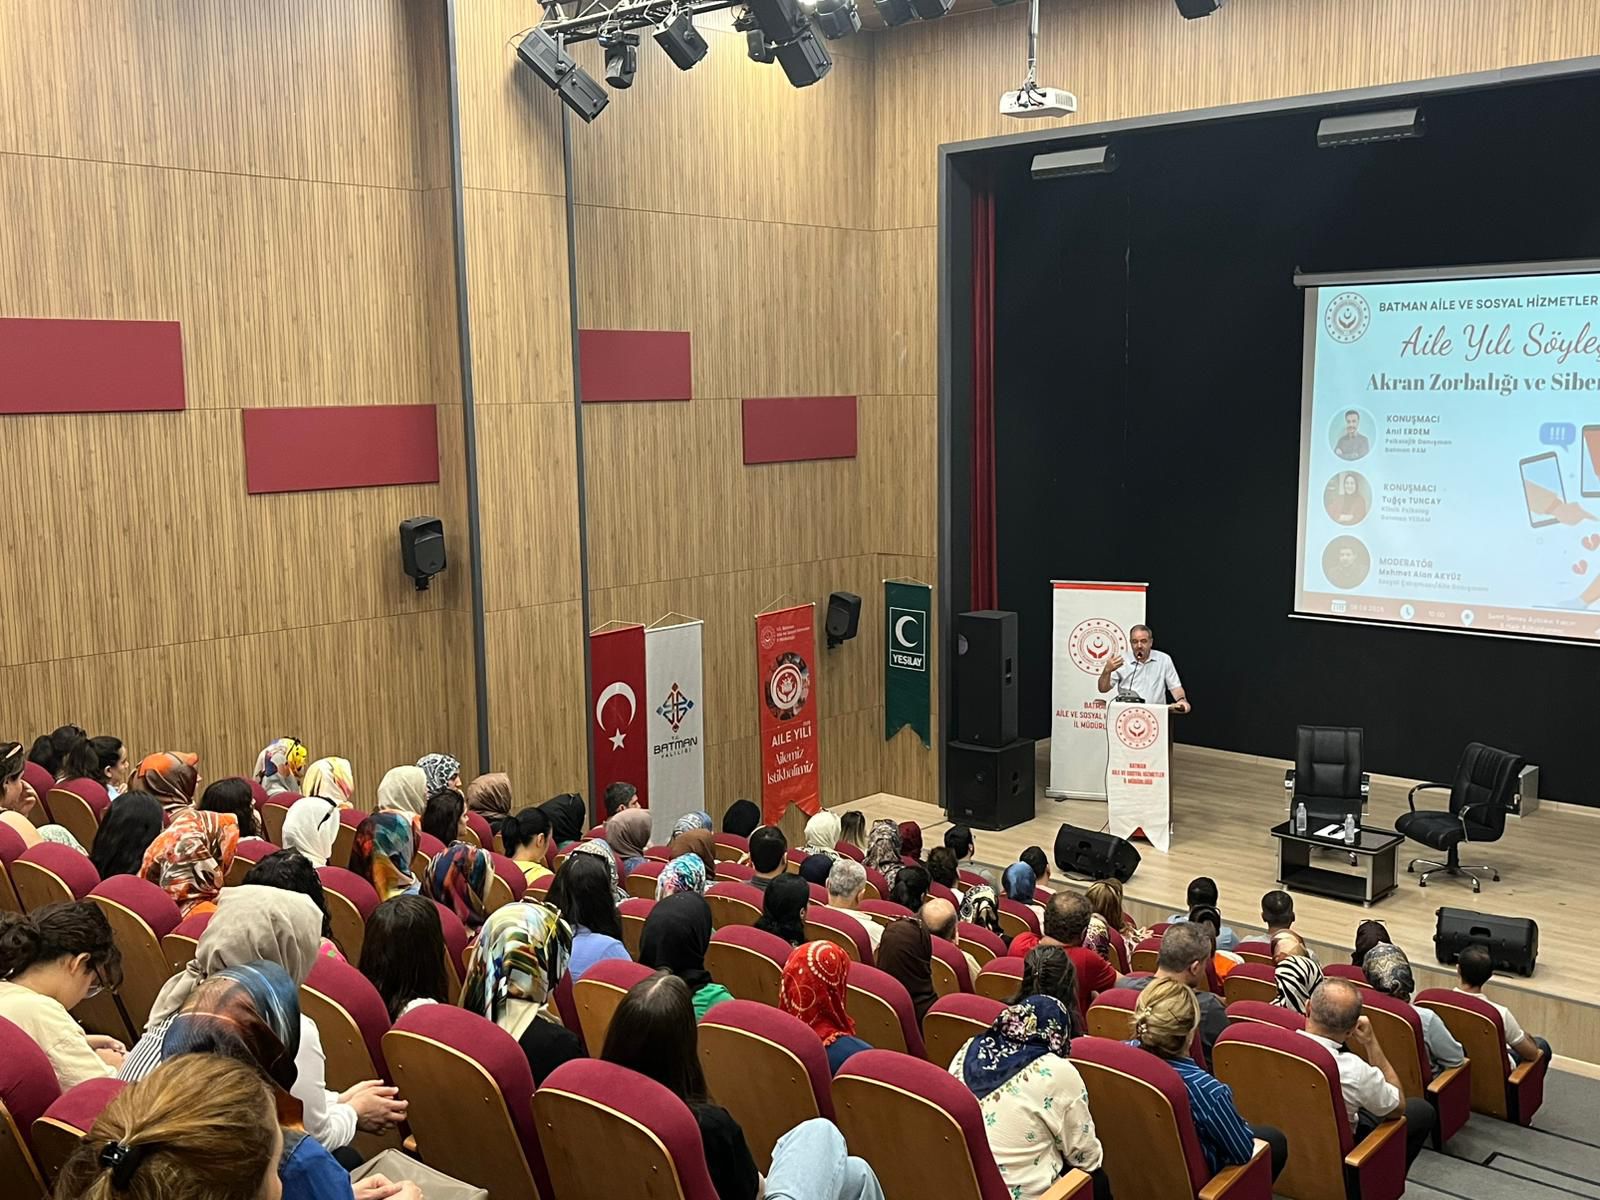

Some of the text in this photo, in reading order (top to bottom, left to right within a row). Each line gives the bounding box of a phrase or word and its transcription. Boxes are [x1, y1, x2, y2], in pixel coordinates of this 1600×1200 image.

[1379, 294, 1599, 312] BATMAN AİLE VE SOSYAL HİZMETLER
[1400, 325, 1454, 359] Aile
[1462, 323, 1515, 362] Yılı
[1366, 372, 1425, 391] Akran
[1429, 371, 1519, 397] Zorbalığı
[1523, 377, 1547, 391] ve
[1385, 414, 1441, 426] KONUŞMACI
[1403, 428, 1431, 436] ERDEM
[1383, 482, 1438, 495] KONUŞMACI
[1408, 496, 1443, 506] TUNCAY
[1378, 557, 1434, 569] MODERATÖR
[1070, 710, 1079, 719] VE
[1079, 711, 1102, 720] SOSYAL
[1080, 720, 1107, 730] MÜDÜRL
[653, 736, 698, 755] BATMAN
